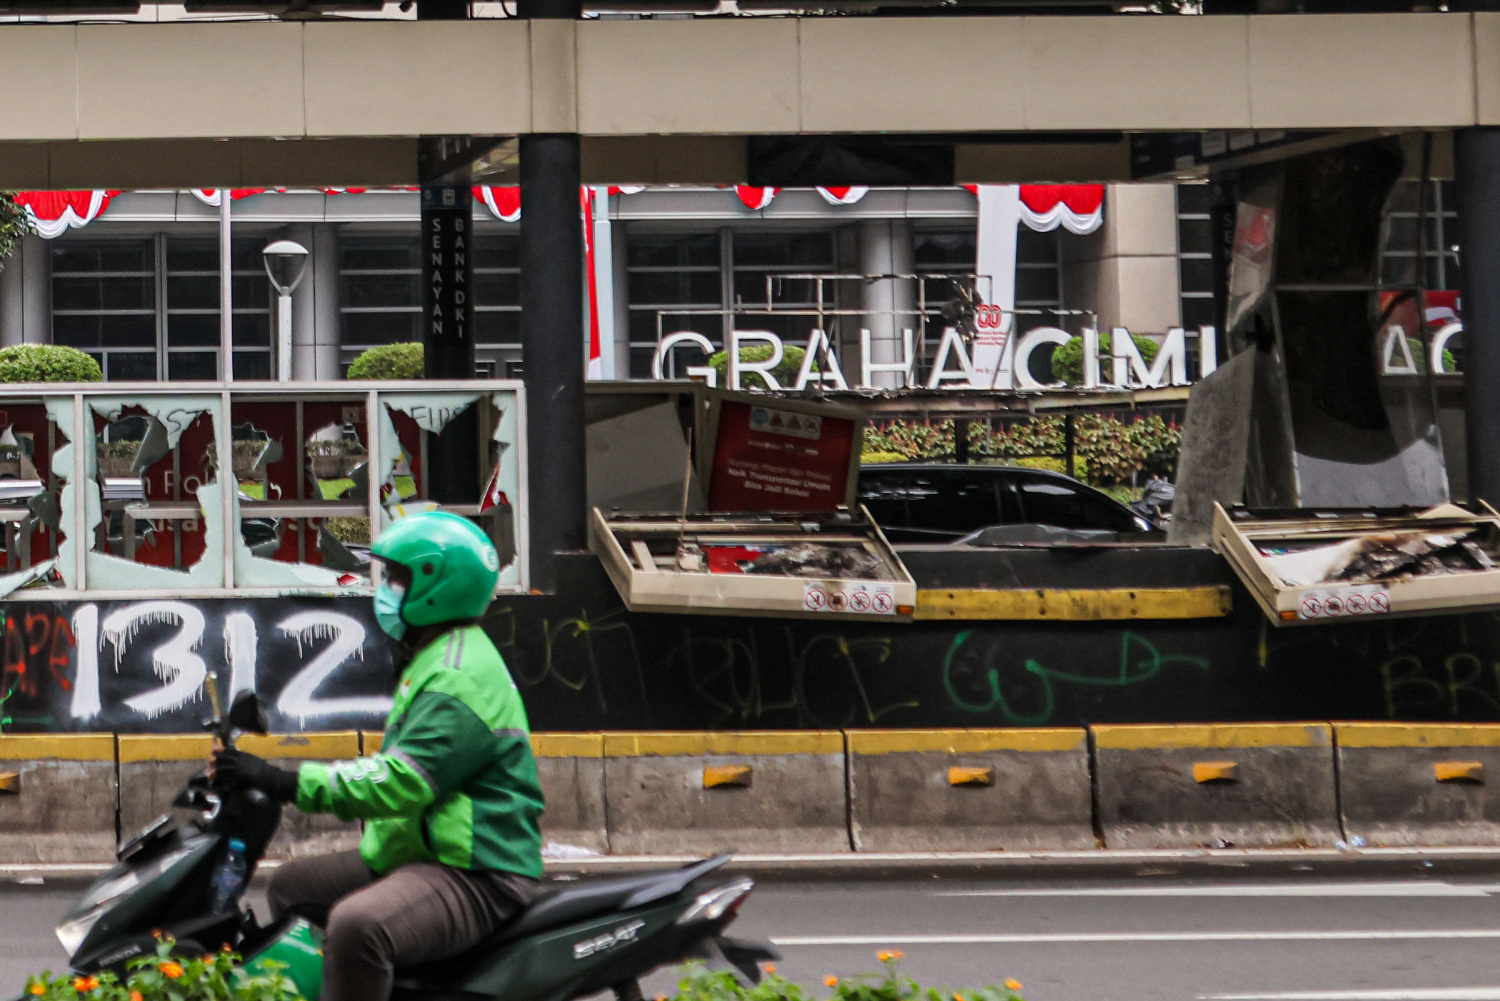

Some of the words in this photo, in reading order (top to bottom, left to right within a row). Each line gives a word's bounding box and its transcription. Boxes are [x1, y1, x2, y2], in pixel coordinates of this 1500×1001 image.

[432, 218, 443, 335] SENAYAN
[455, 218, 465, 283] BANK
[455, 290, 465, 338] DKI
[652, 328, 977, 391] GRAHA
[70, 600, 395, 730] 1312
